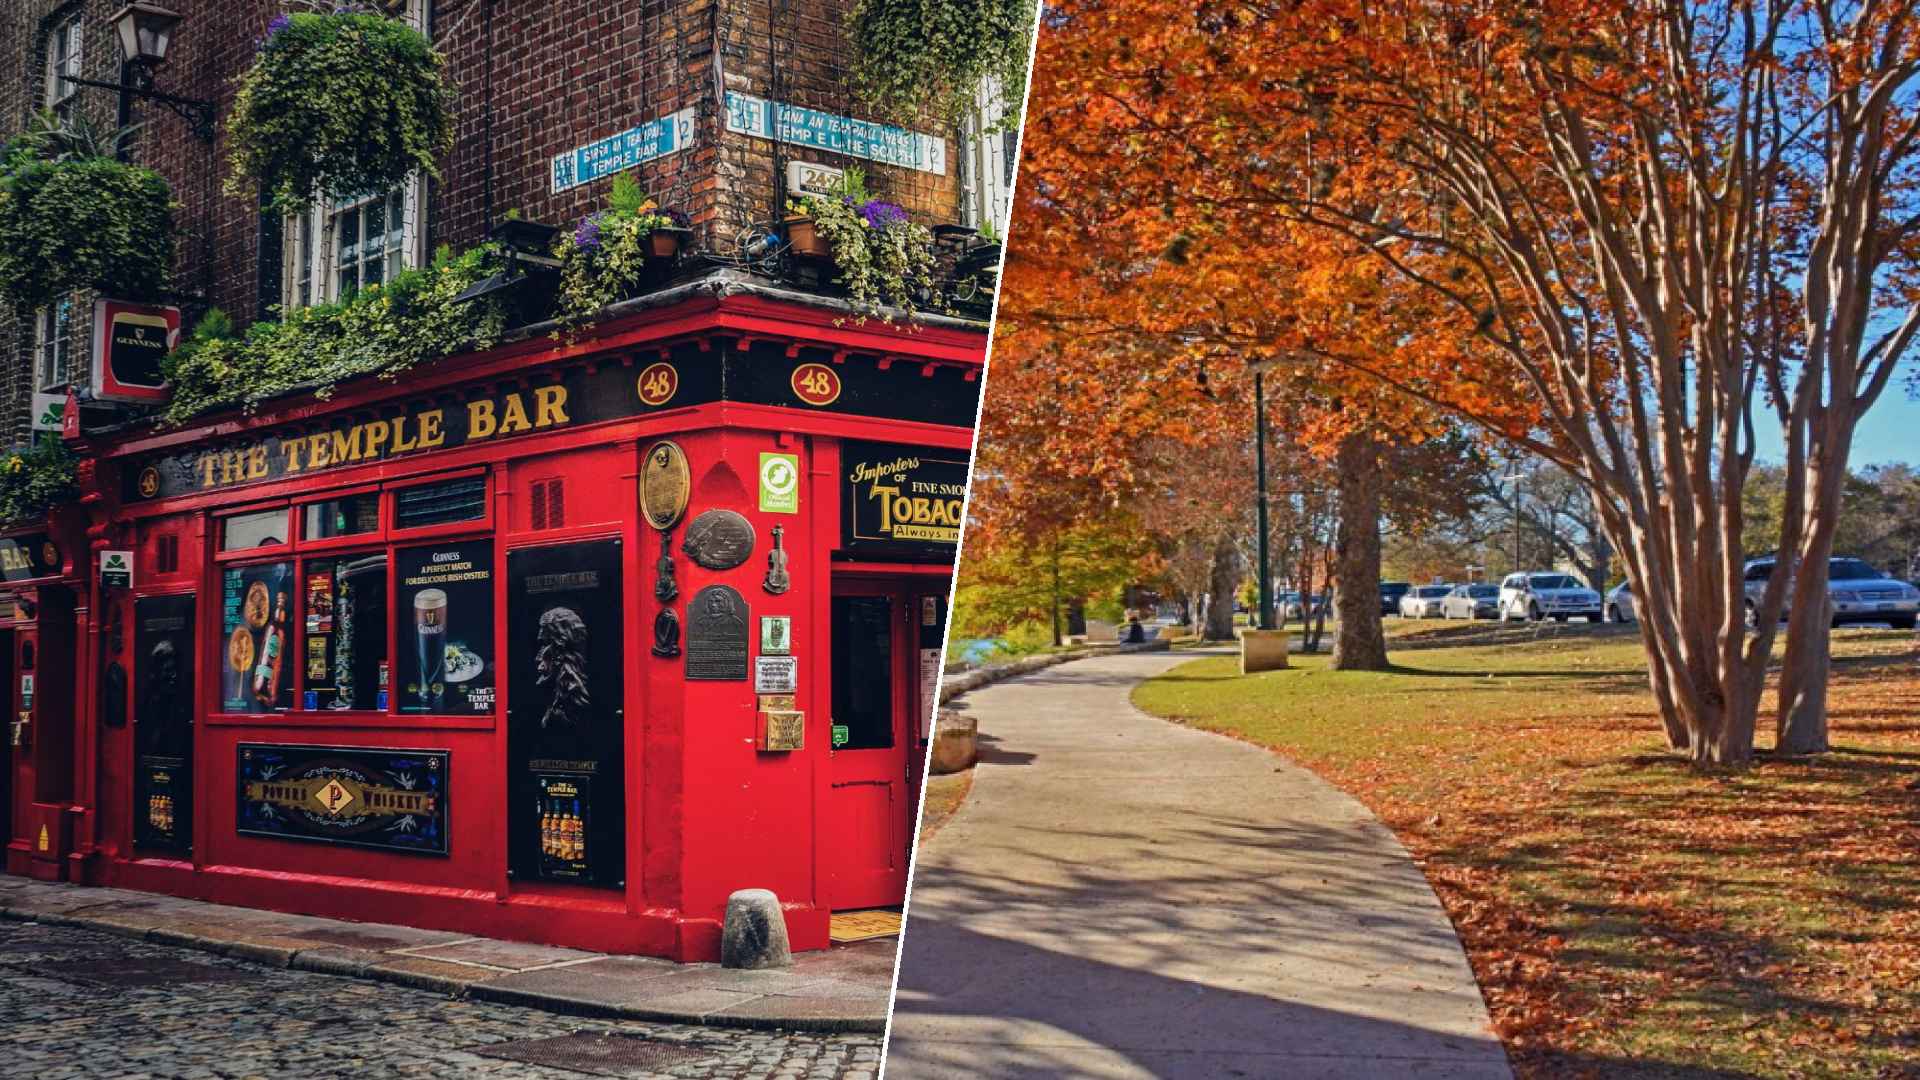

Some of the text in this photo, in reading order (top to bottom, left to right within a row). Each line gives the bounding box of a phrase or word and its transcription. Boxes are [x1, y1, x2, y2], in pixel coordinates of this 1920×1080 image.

[680, 120, 689, 140] 2
[809, 113, 823, 129] AN
[776, 124, 827, 145] TEMPE
[832, 133, 865, 153] LNE
[592, 150, 632, 174] TEMPLE
[636, 142, 658, 159] BAR
[117, 337, 162, 348] GUINNESS
[645, 370, 670, 398] 48
[800, 370, 831, 397] 48
[198, 383, 571, 488] THE TEMPLE BAR
[850, 457, 920, 485] Importers
[894, 474, 907, 483] OF
[912, 481, 938, 493] FINE
[869, 485, 962, 533] TOBAC
[896, 525, 941, 539] Always
[1, 547, 35, 571] BAR
[432, 552, 460, 562] GUINNESS
[467, 694, 495, 703] TEMPLE
[474, 702, 489, 710] BAR
[363, 789, 421, 810] WHISKEY
